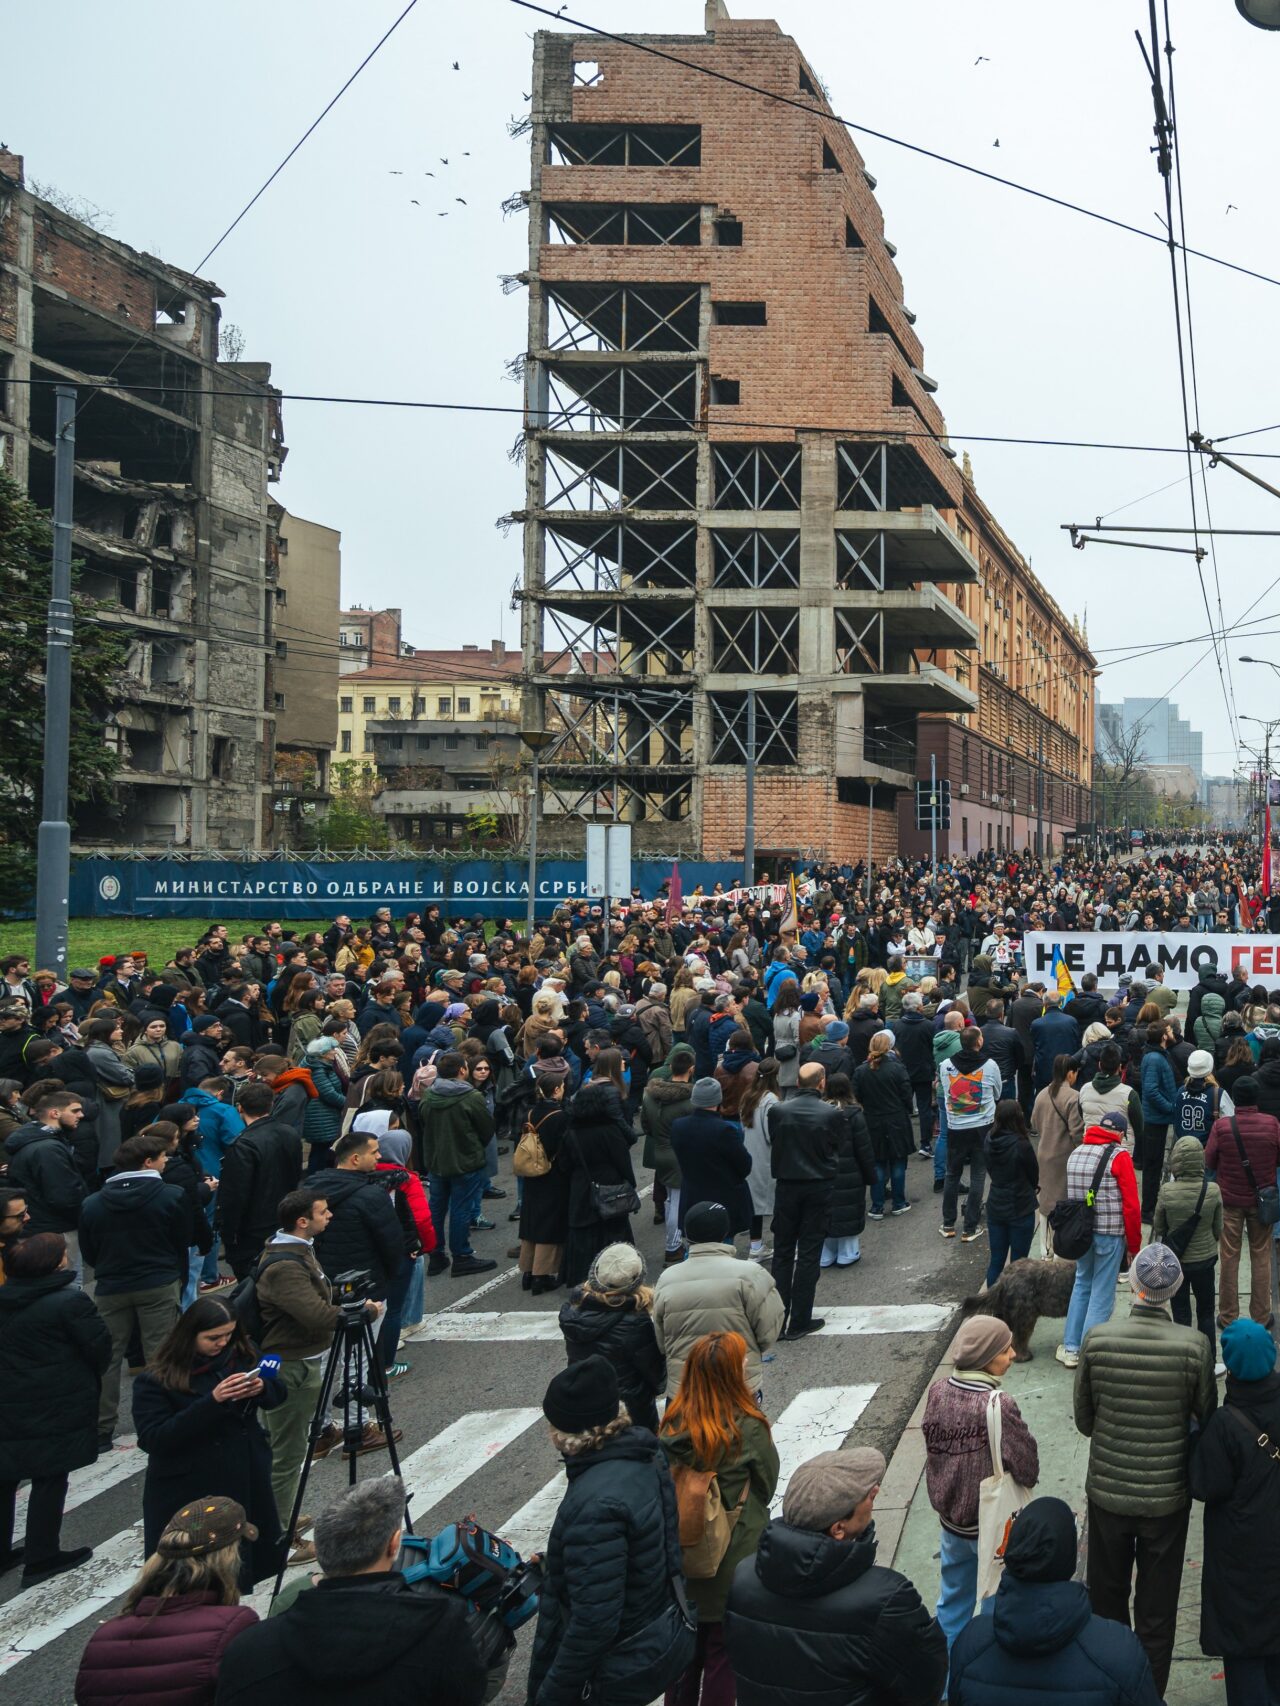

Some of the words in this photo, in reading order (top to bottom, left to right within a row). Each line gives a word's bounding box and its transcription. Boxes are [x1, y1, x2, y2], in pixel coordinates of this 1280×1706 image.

[154, 880, 319, 895] МИНИСТАРСТВО
[326, 881, 424, 897] ОДБРАНЕ
[433, 881, 445, 894] И
[453, 880, 531, 896] ВОЈСКА
[539, 880, 589, 895] СРБИ
[1035, 942, 1085, 972] НЕ
[1096, 943, 1219, 977] ДАМО
[1181, 1104, 1206, 1131] 92
